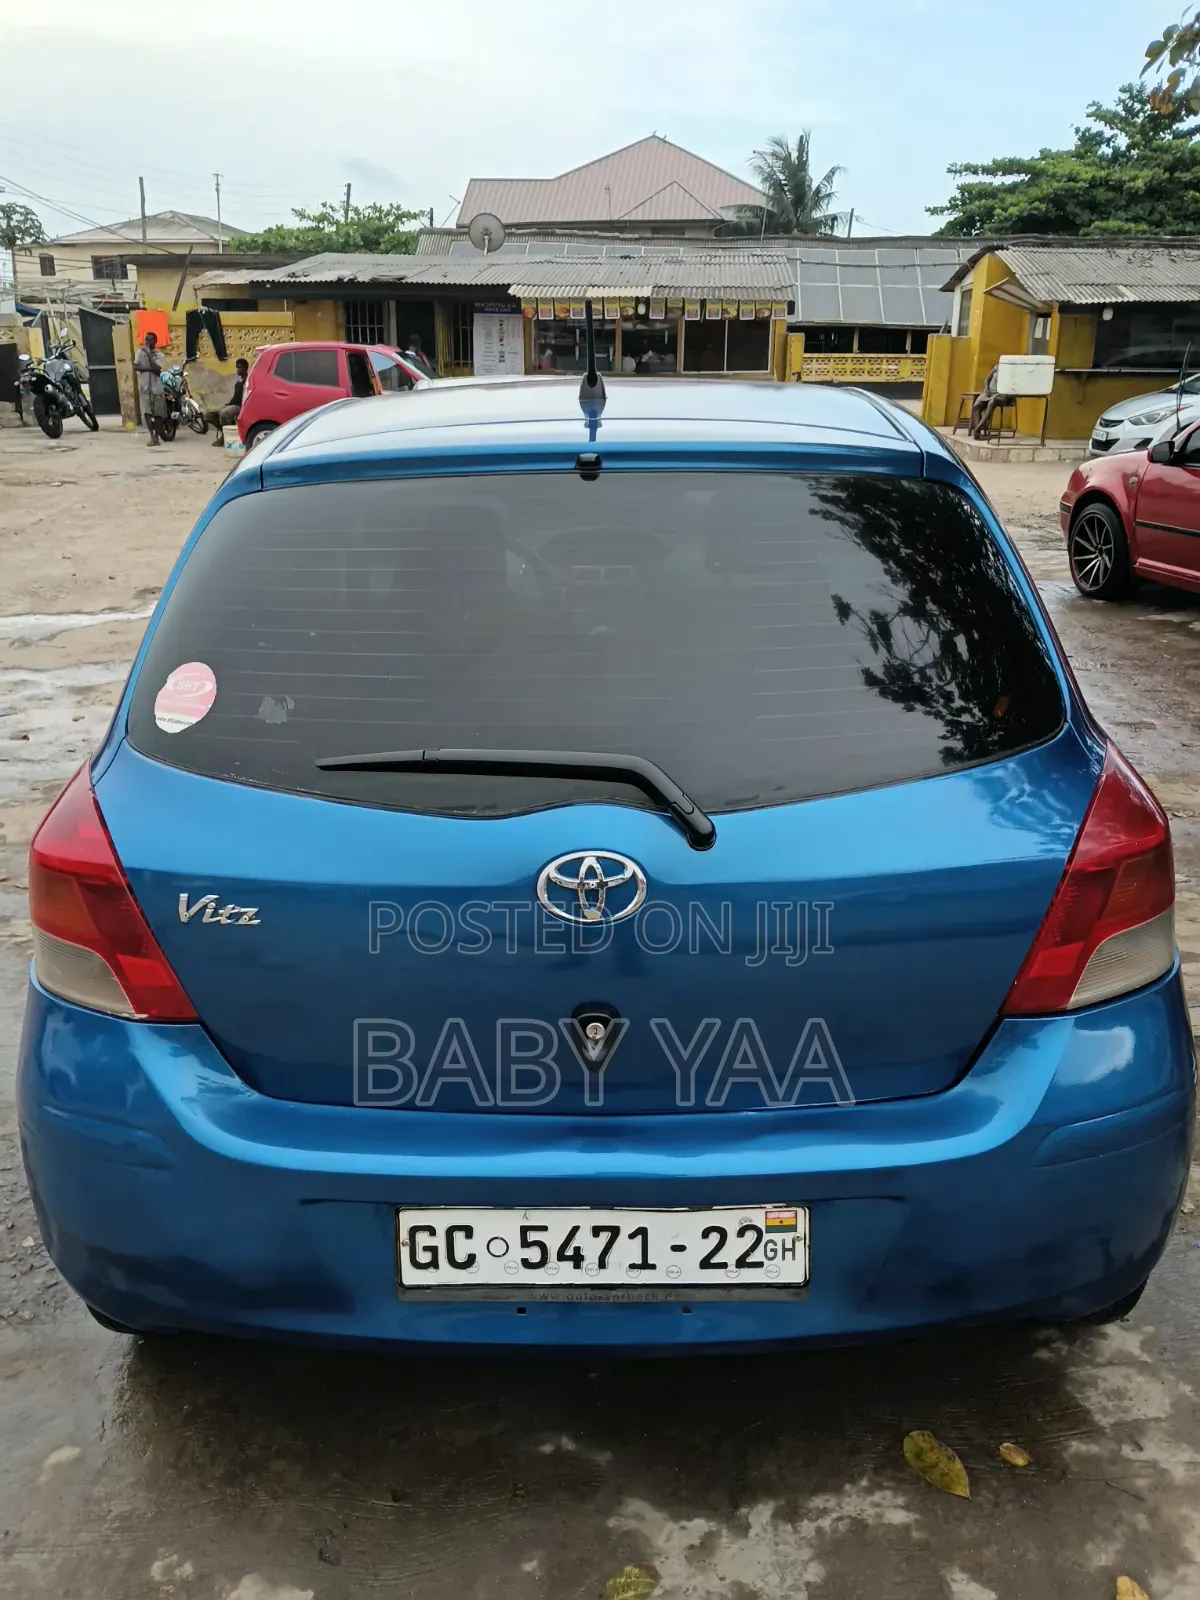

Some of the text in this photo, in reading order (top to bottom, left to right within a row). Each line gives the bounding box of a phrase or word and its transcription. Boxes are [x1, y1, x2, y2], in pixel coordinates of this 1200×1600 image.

[178, 893, 261, 924] Vitz
[408, 1224, 476, 1270] GC
[764, 1238, 796, 1262] GH
